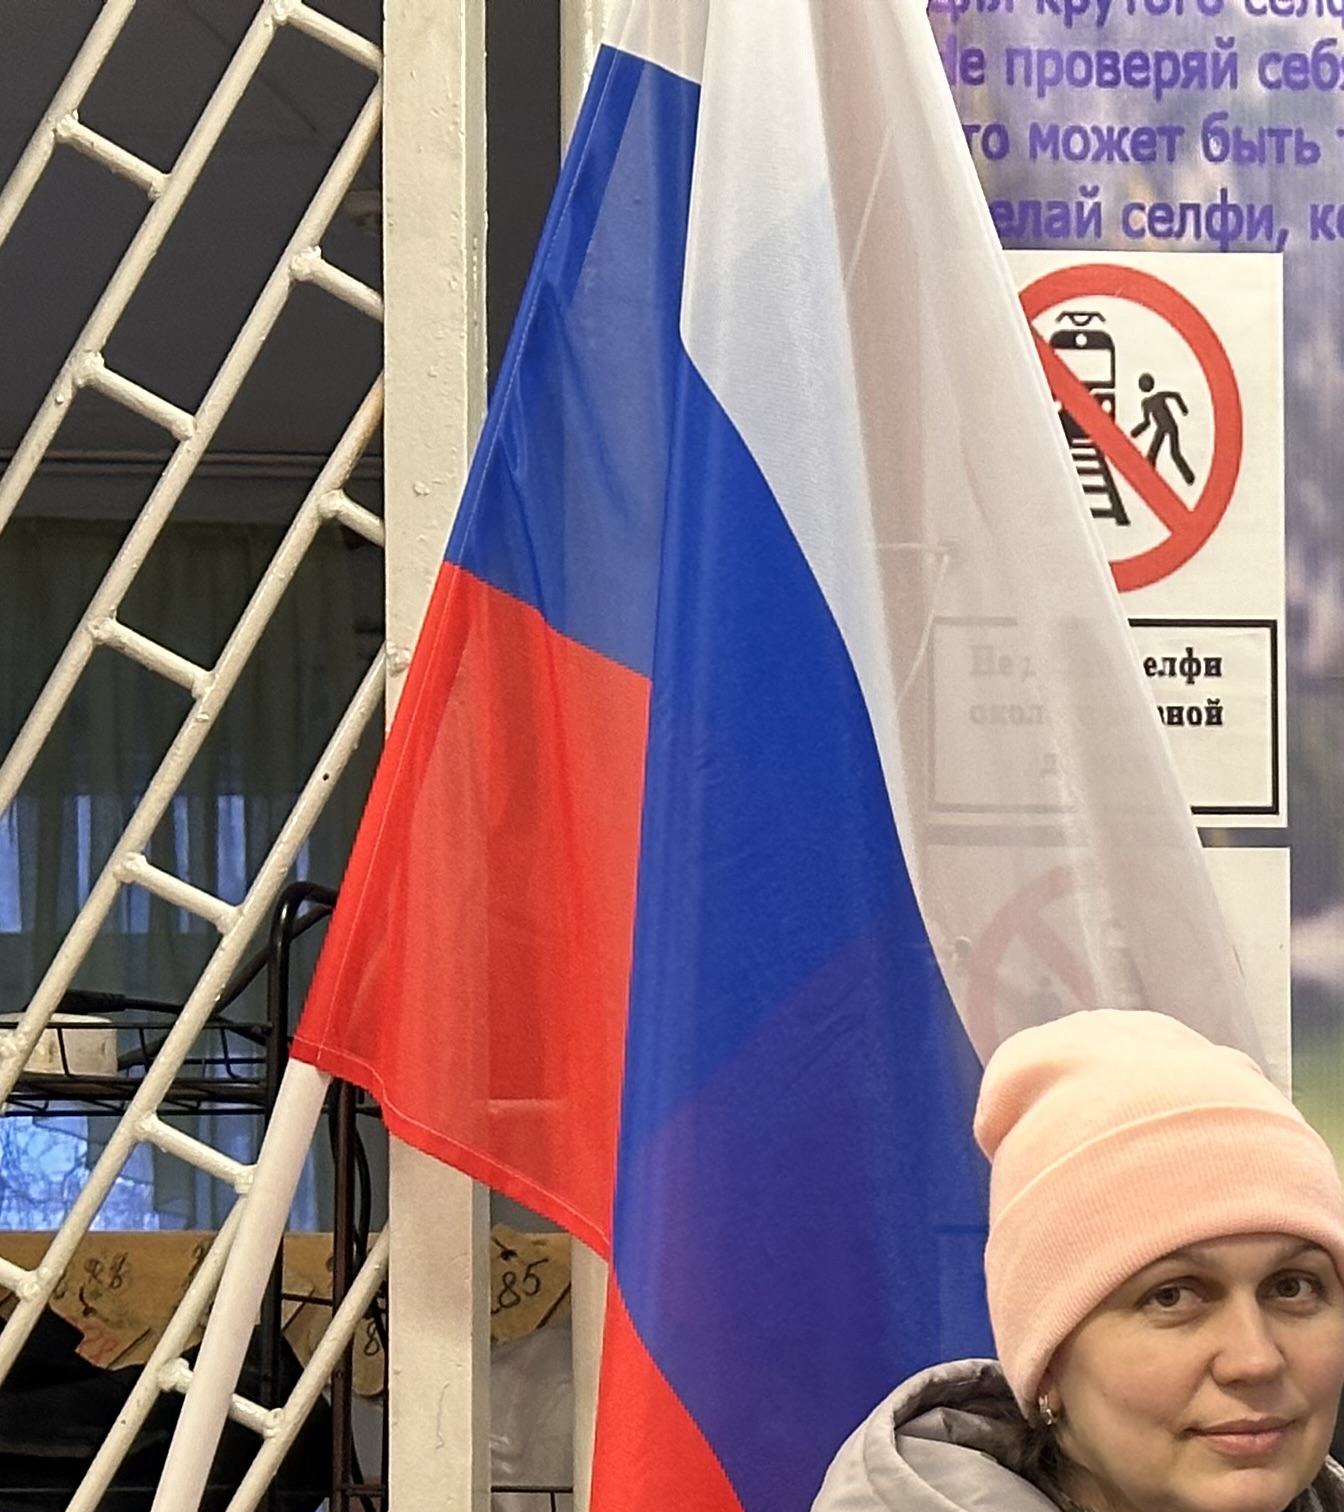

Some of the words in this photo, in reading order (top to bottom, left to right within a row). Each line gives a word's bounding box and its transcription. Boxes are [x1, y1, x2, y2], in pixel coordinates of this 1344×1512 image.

[1005, 37, 1239, 101] проверяй
[962, 124, 1010, 161] то
[1029, 122, 1185, 162] может
[1201, 111, 1322, 165] быть
[990, 186, 1103, 239] елай
[1123, 188, 1290, 252] селфи,
[1143, 647, 1223, 685] елфи
[1157, 698, 1224, 726] ной
